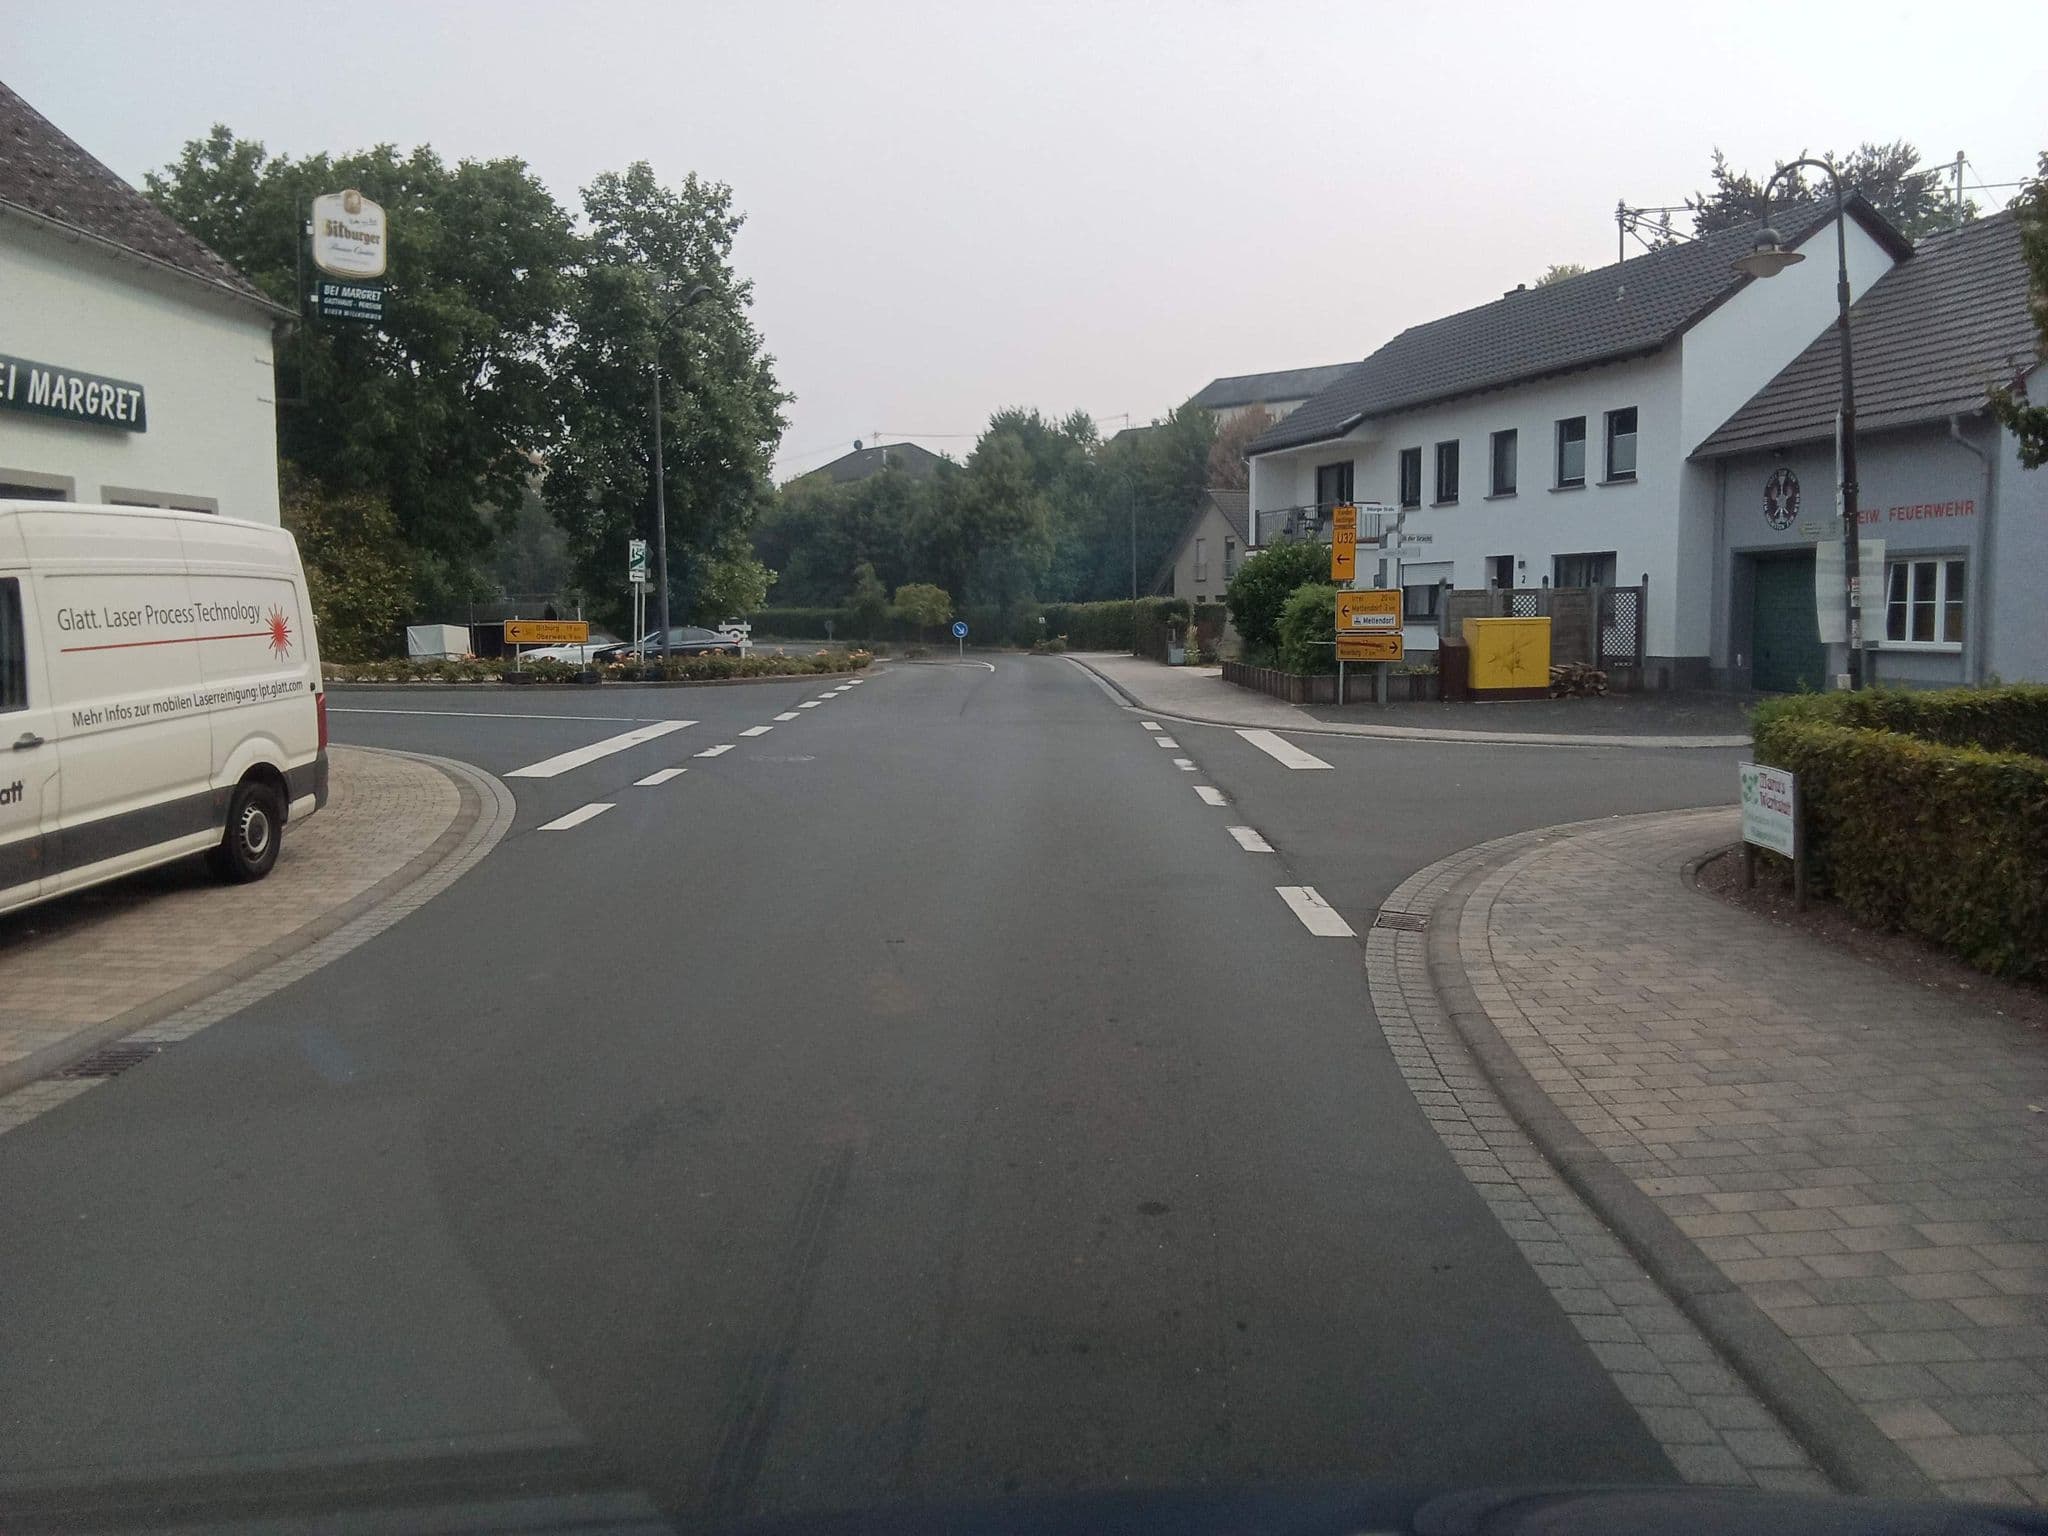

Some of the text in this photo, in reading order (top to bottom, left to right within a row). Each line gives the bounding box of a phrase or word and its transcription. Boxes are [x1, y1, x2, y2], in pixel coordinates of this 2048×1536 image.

[324, 285, 382, 301] BEI MARGRET
[27, 369, 141, 422] MARGRET
[1888, 500, 1975, 522] FEUERWEHR
[1337, 532, 1354, 544] U32
[57, 600, 261, 631] Glatt. Laser Process Technology
[1363, 616, 1395, 625] Mettendorf
[72, 681, 303, 728] Mehr Infos zur mobilen Laserreinigung: lpt.glatt.com
